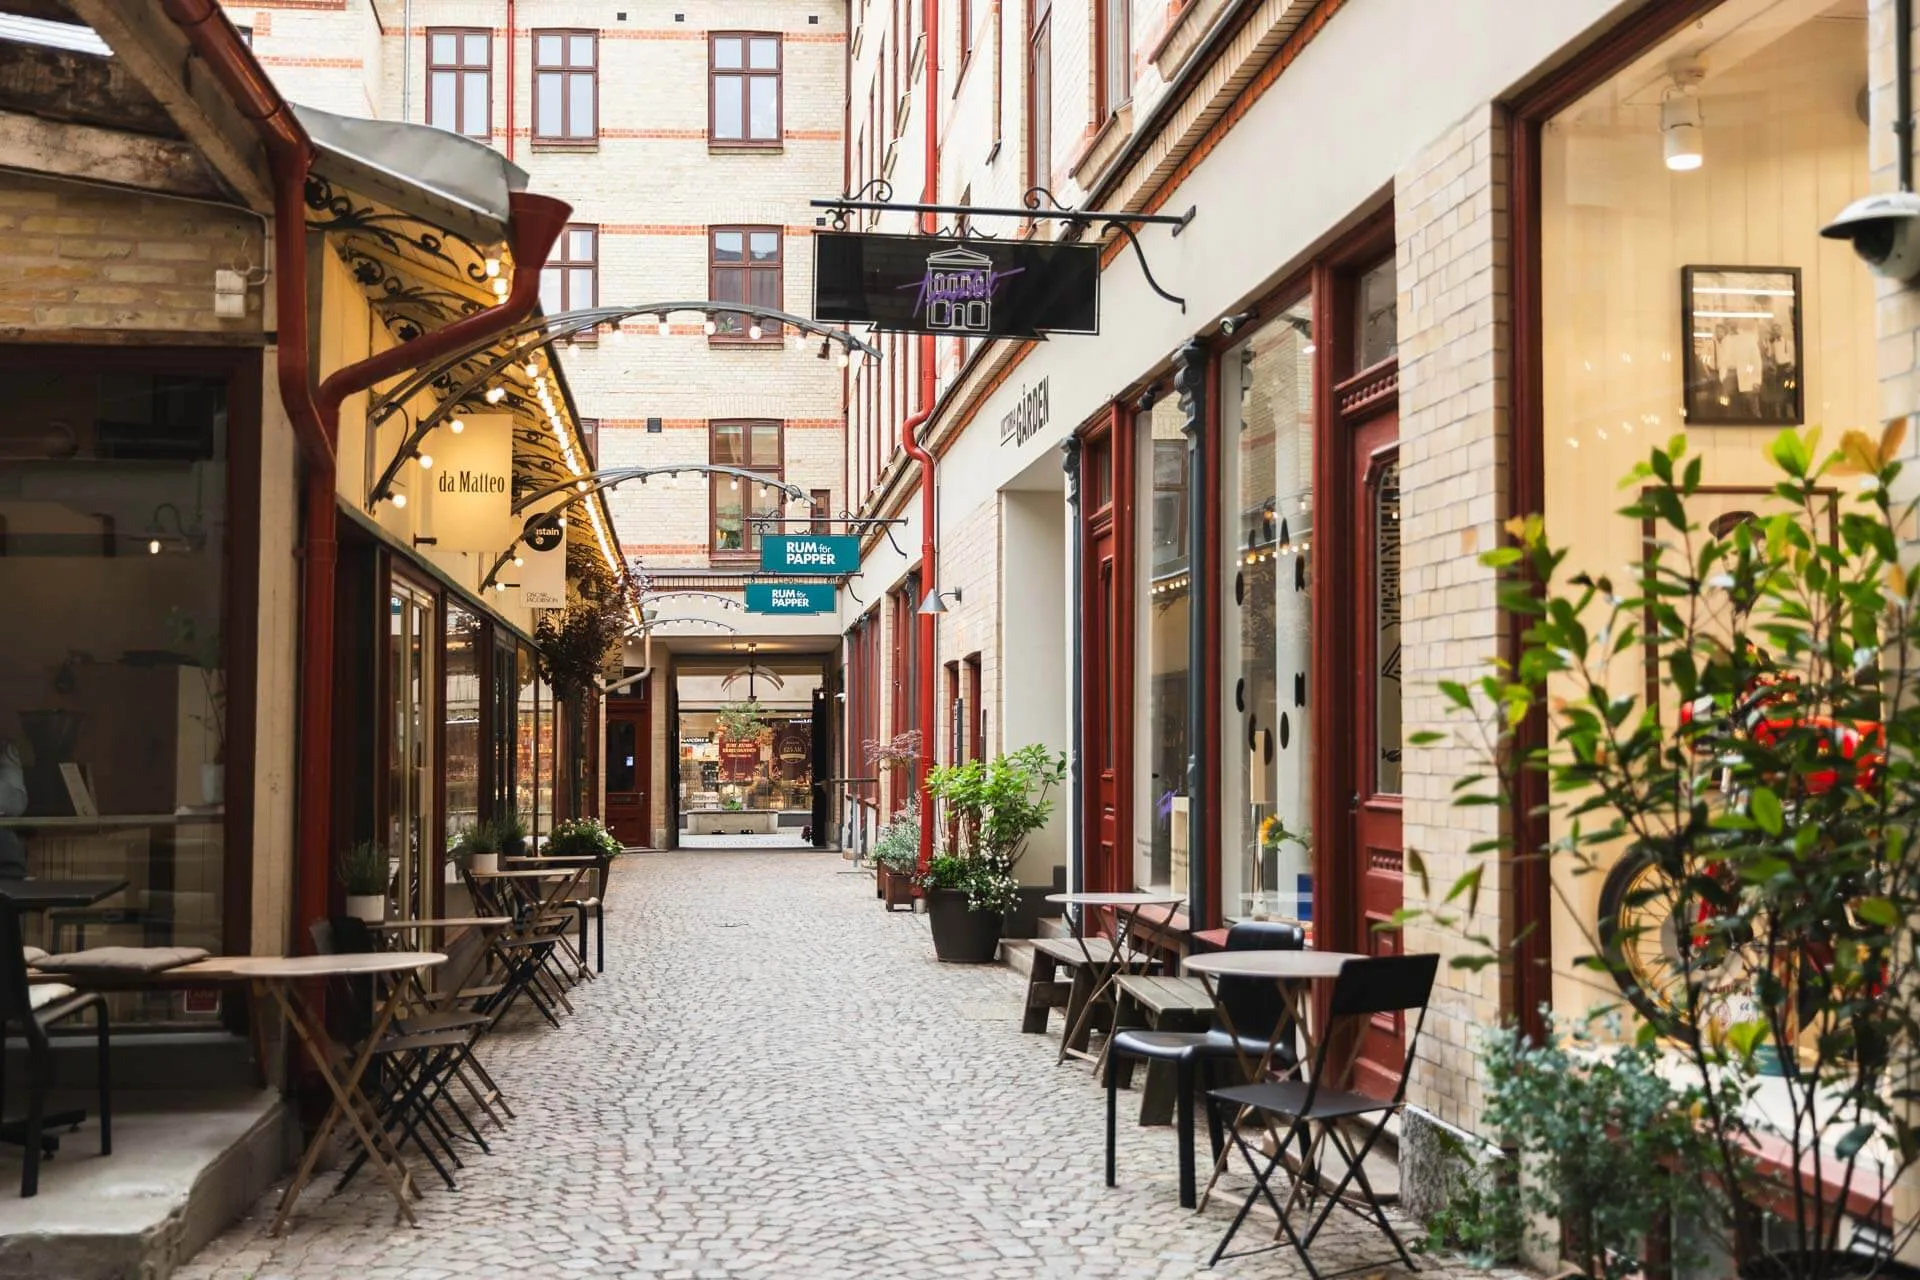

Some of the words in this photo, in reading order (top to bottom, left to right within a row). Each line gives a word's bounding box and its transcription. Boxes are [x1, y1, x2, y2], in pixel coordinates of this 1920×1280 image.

[1016, 375, 1049, 448] GÅRDEN
[439, 471, 454, 493] da
[459, 471, 505, 493] Matteo
[786, 541, 817, 553] RUM
[818, 543, 832, 554] för
[786, 554, 836, 565] PAPPER
[772, 589, 796, 598] RUM
[796, 590, 806, 598] för
[772, 598, 809, 607] PAPPER
